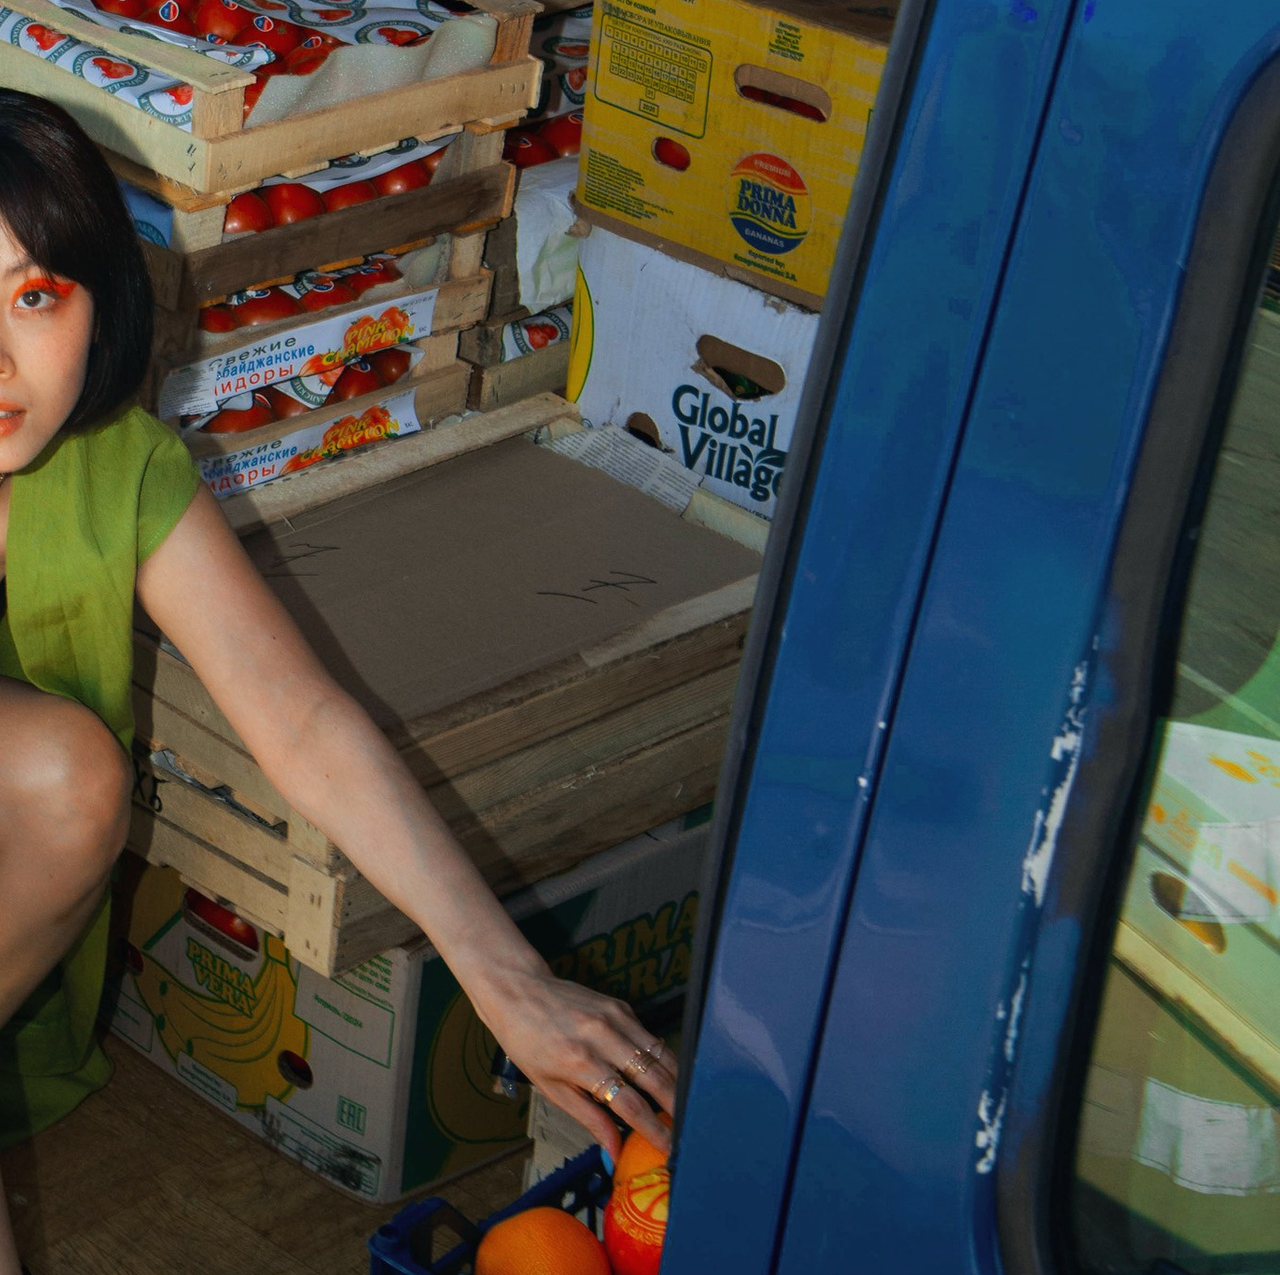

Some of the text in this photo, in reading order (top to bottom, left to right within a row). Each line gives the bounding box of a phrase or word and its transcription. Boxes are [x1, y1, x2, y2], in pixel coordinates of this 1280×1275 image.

[754, 158, 792, 178] PREMIUM
[737, 193, 797, 229] DONNA
[740, 178, 797, 213] PRIMA
[744, 227, 785, 248] BANANAS
[347, 319, 387, 343] PINK
[214, 364, 293, 396] идоры
[216, 345, 315, 381] байджанские
[327, 416, 369, 442] PINK
[672, 384, 779, 449] Global
[186, 937, 258, 1000] PRIMA
[193, 962, 254, 1018] VERA
